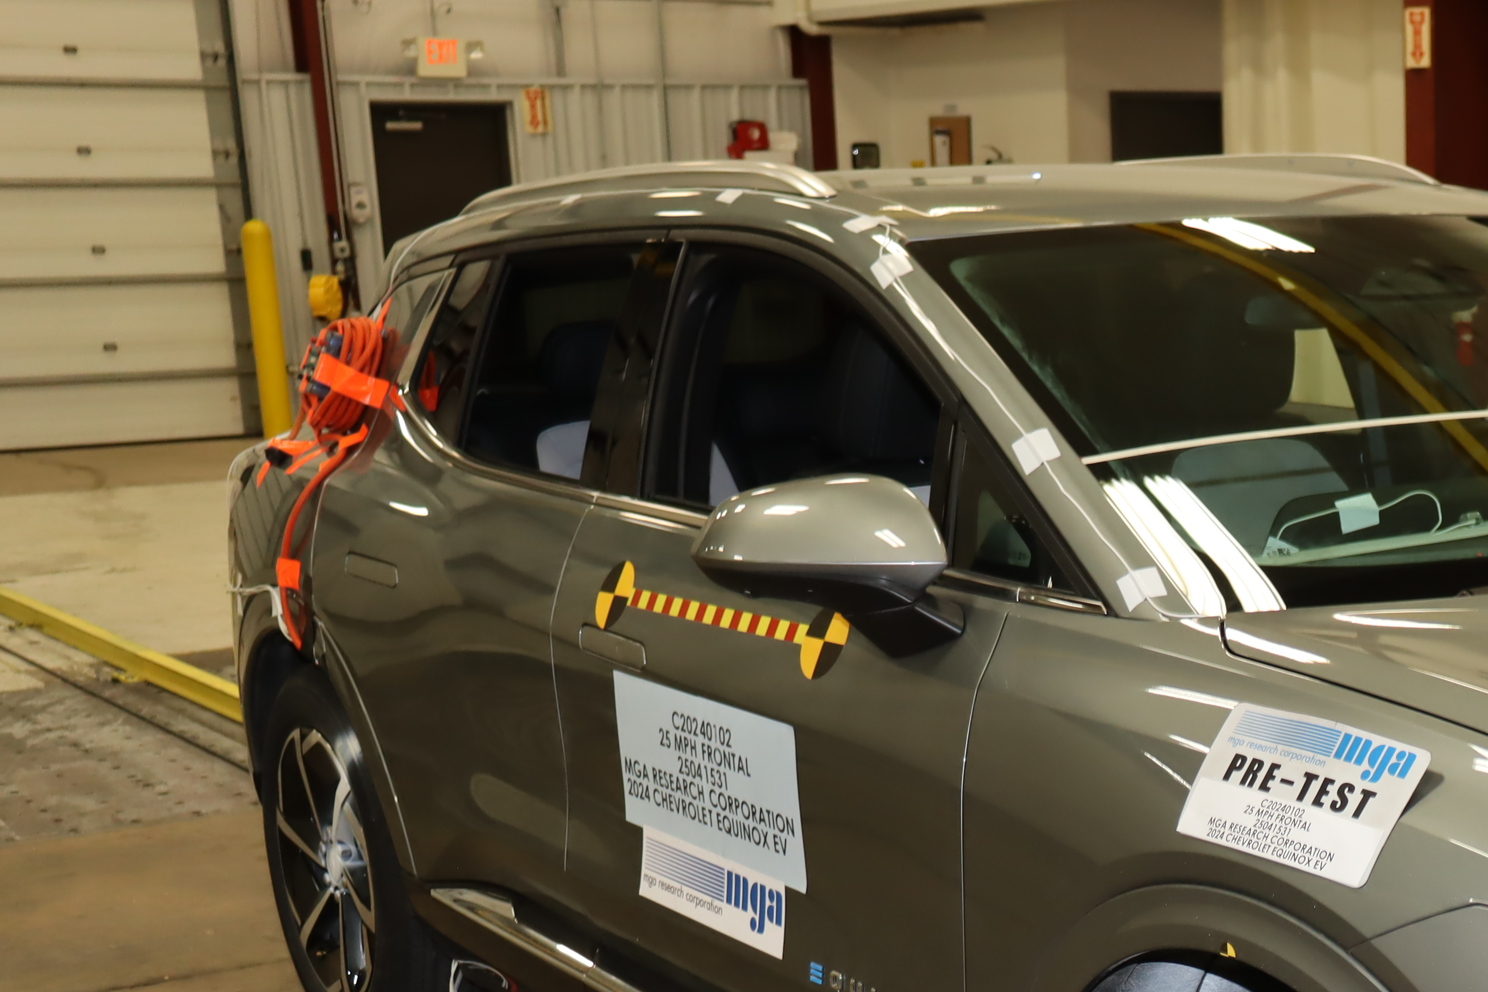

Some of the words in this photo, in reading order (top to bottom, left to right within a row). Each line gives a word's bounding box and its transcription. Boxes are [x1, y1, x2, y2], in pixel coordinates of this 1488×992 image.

[426, 38, 458, 65] EXIT
[671, 711, 732, 748] C20240102
[659, 729, 672, 749] 25
[674, 736, 698, 759] MPH
[701, 744, 751, 778] FRONTAL
[678, 756, 728, 791] 25041531
[1227, 736, 1245, 748] mga
[1246, 741, 1278, 756] research
[1279, 748, 1326, 768] corporation
[1333, 732, 1418, 784] mga
[624, 757, 649, 781] MGA
[652, 767, 706, 803] RESEARCH
[709, 790, 795, 838] CORPORATION
[1221, 753, 1378, 820] PRE-TEST
[627, 778, 651, 803] 2024
[652, 790, 714, 828] CHEVROLET
[716, 814, 770, 850] EQUINOX
[773, 835, 788, 857] EV
[1243, 804, 1256, 816] 25
[1256, 808, 1275, 822] MPH
[1276, 812, 1312, 833] FRONTAL
[1253, 818, 1292, 837] 25041531
[1260, 799, 1306, 819] C20240102
[1206, 828, 1225, 842] 2024
[1225, 832, 1272, 856] CHEVROLET
[1271, 846, 1313, 868] EQUINOX
[1313, 860, 1328, 872] EV
[1207, 816, 1227, 831] MGA
[1228, 821, 1270, 842] RESEARCH
[1270, 833, 1336, 864] CORPORATION
[643, 873, 657, 891] mga
[658, 878, 684, 899] research
[685, 890, 724, 916] corporation
[726, 869, 783, 934] mga
